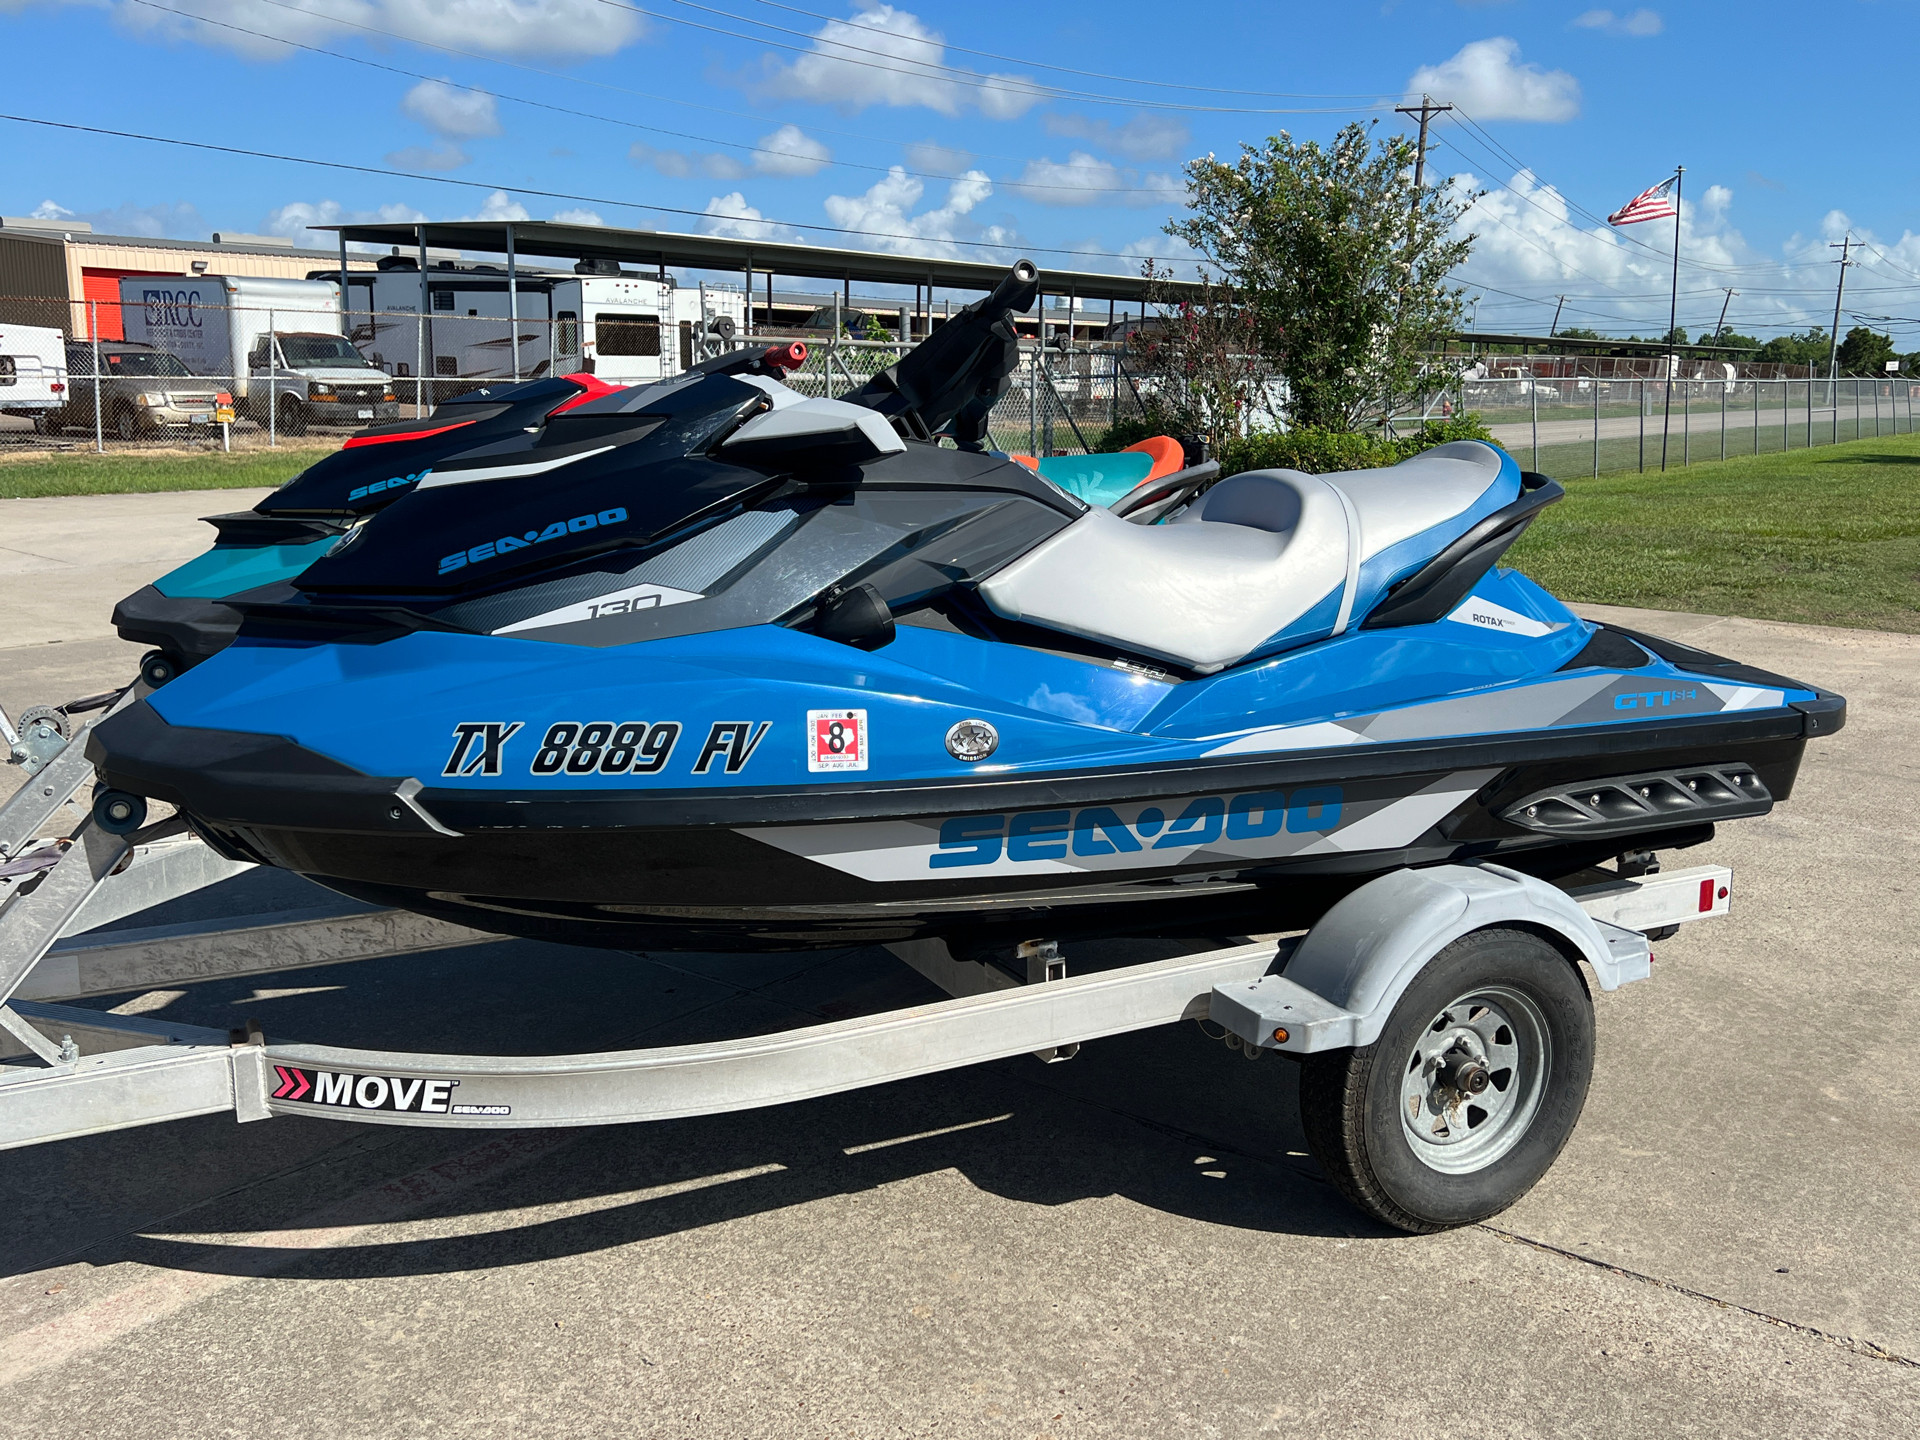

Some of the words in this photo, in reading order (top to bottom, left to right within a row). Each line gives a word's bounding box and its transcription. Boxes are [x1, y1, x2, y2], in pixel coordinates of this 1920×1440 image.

[161, 290, 203, 328] RCC
[588, 594, 662, 619] 130
[1472, 613, 1504, 628] ROTAX
[1614, 690, 1671, 710] GTI
[441, 722, 526, 777] TX
[529, 721, 683, 776] 8889
[690, 721, 774, 775] FV
[828, 722, 845, 754] 8
[958, 752, 988, 762] EMISSION
[313, 1071, 452, 1113] MOVE
